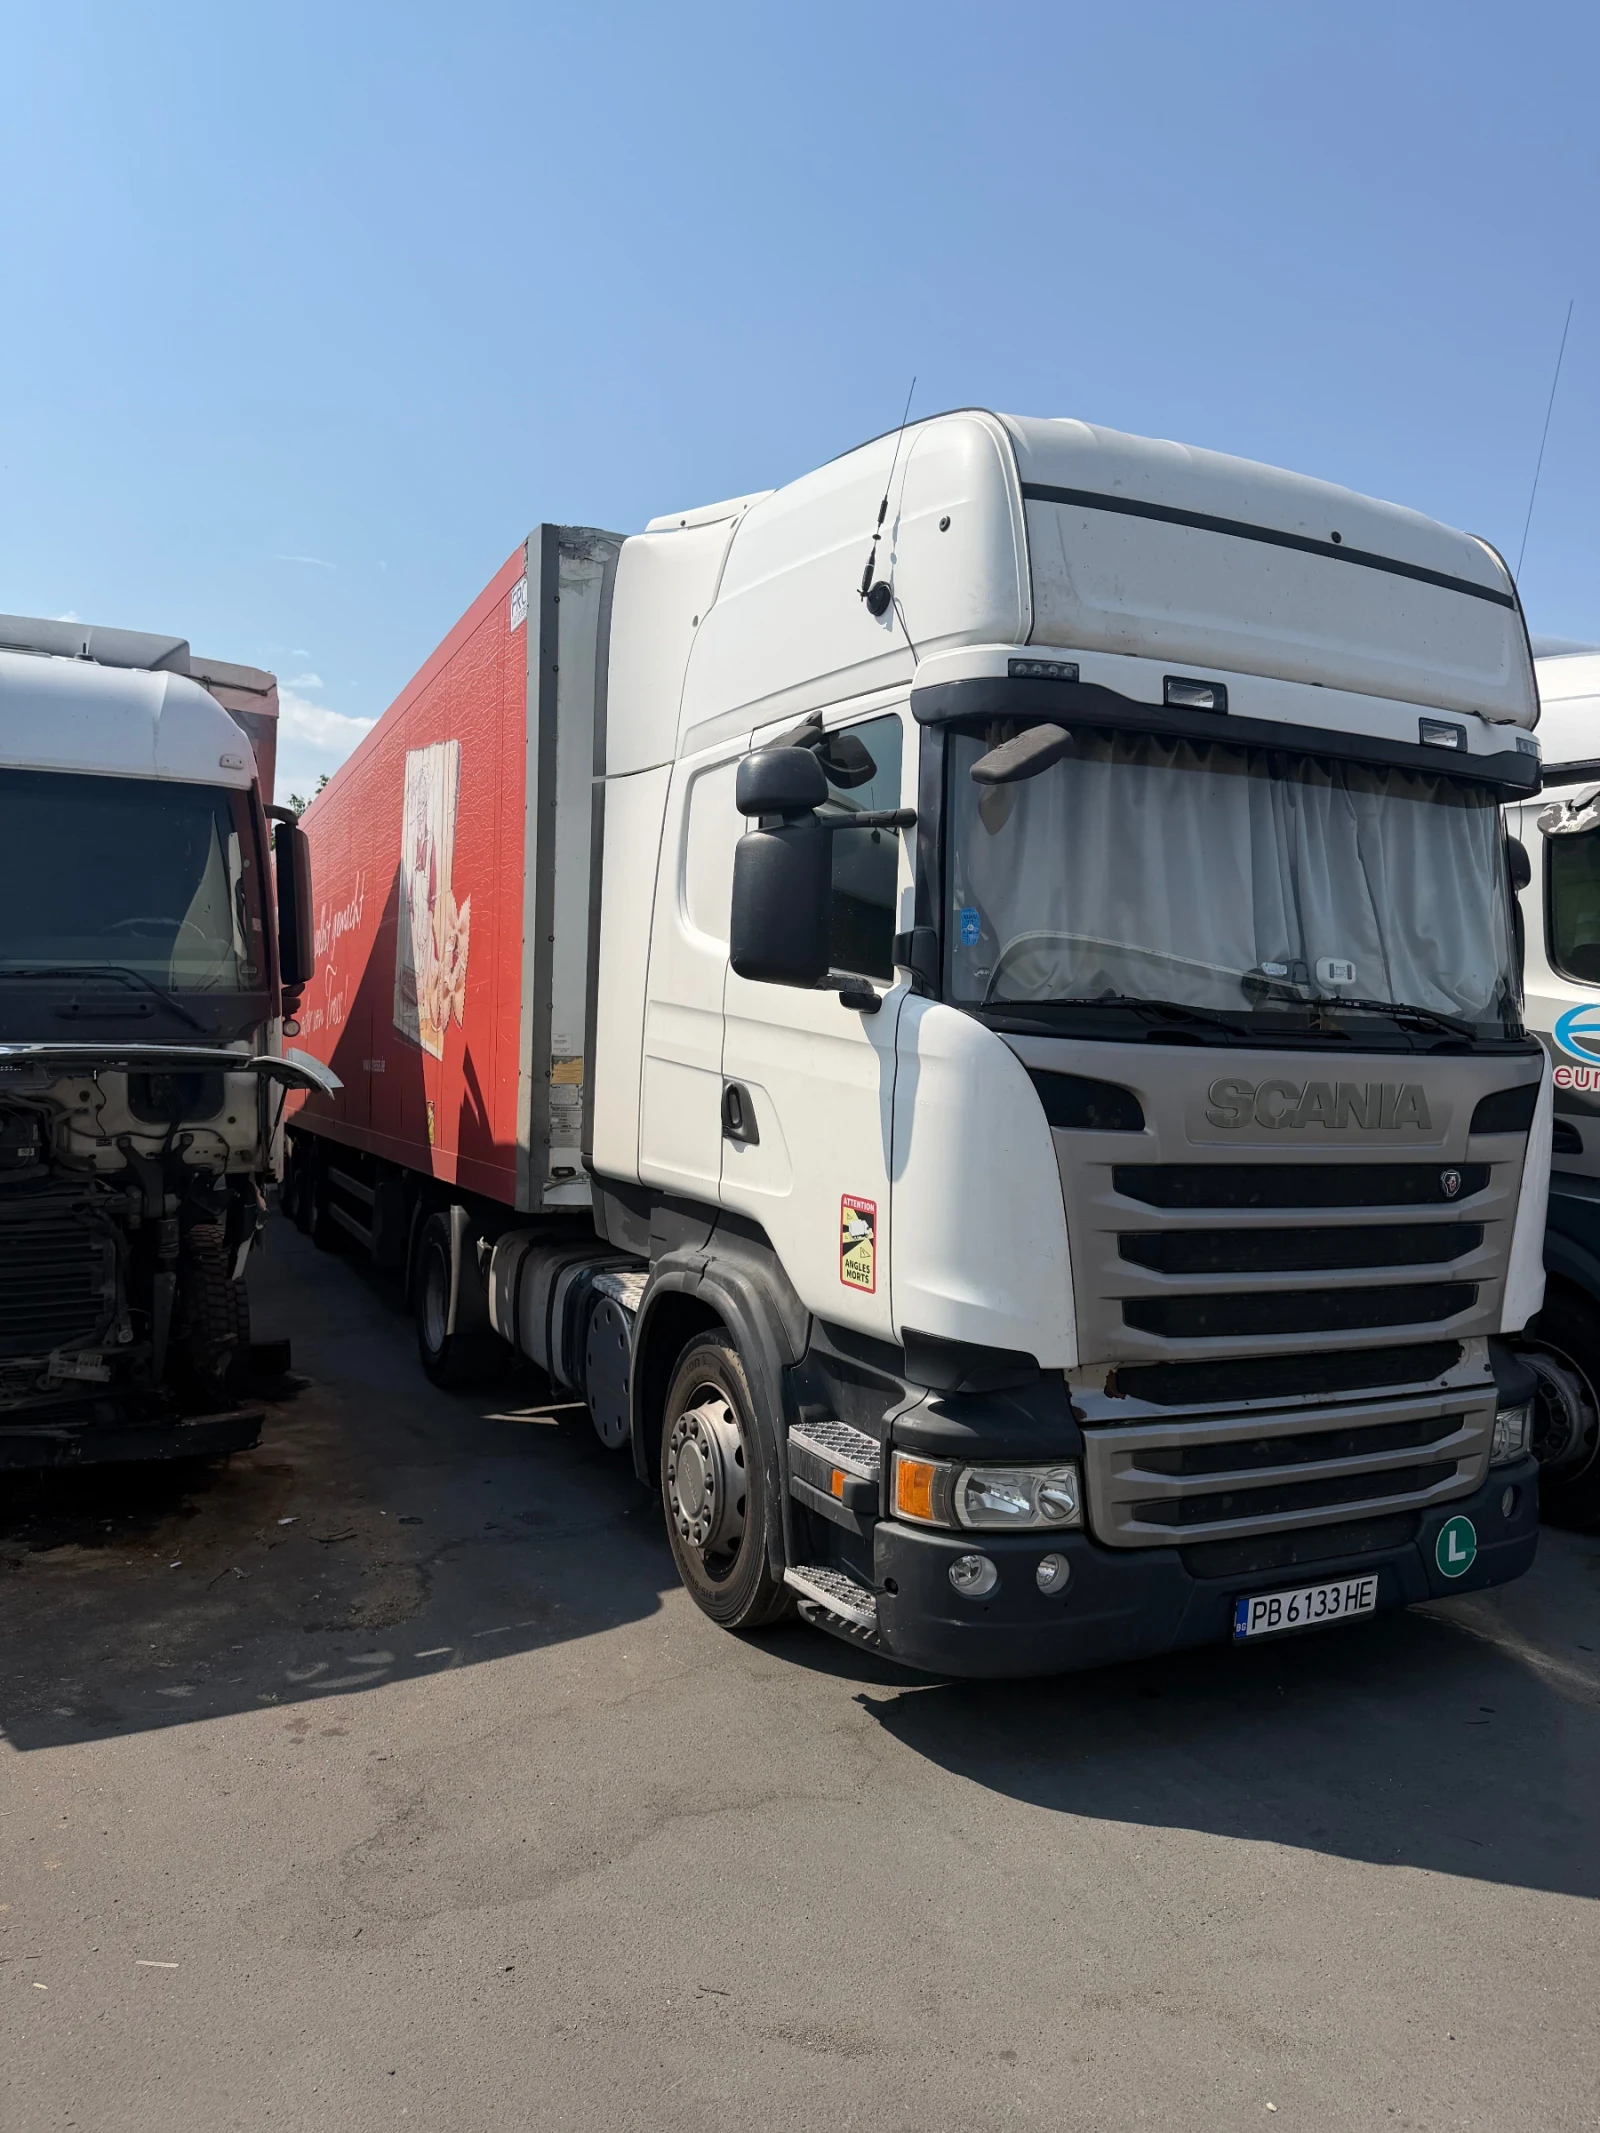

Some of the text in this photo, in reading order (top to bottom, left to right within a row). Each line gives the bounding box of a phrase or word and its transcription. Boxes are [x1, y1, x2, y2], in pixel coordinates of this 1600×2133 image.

[1205, 1076, 1432, 1130] SCANIA
[843, 1196, 875, 1212] ATTENTION
[845, 1259, 871, 1274] ANGLES
[846, 1269, 870, 1284] MORTS
[1448, 1530, 1466, 1562] L
[1251, 1580, 1373, 1630] PB 6133 HE
[1236, 1622, 1247, 1632] BG
